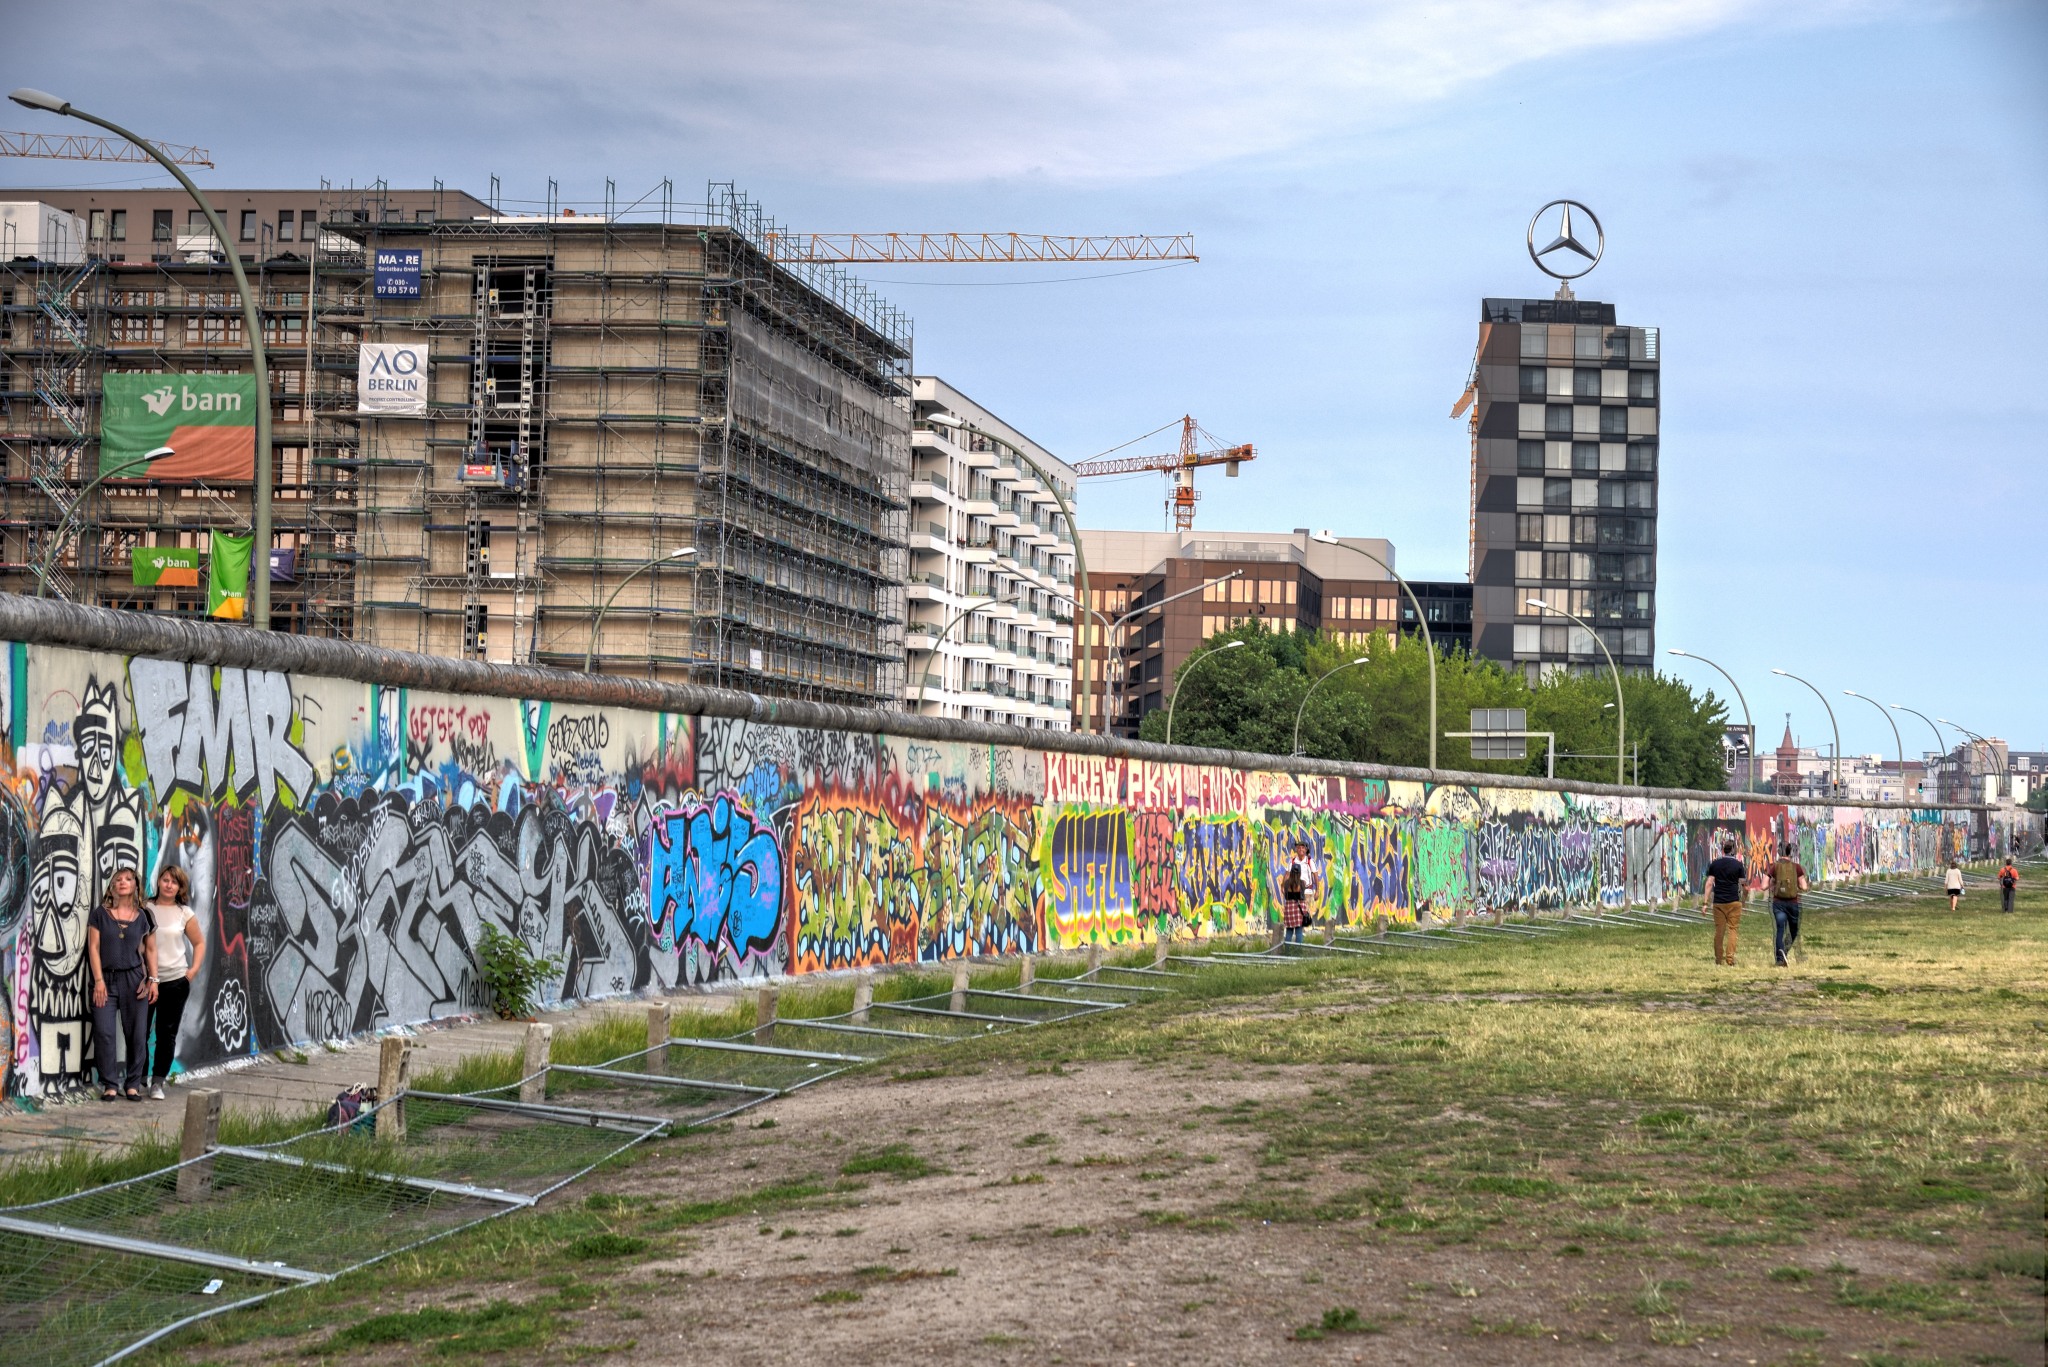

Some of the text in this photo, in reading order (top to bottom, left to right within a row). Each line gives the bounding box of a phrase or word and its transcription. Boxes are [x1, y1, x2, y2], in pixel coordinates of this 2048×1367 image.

[378, 254, 397, 265] MA
[405, 255, 419, 265] RE
[377, 286, 418, 294] 97 89 57 01
[368, 378, 418, 391] BERLIN
[181, 385, 241, 411] bam
[167, 556, 190, 568] bam
[226, 589, 242, 598] bam
[1126, 758, 1184, 810] PKM
